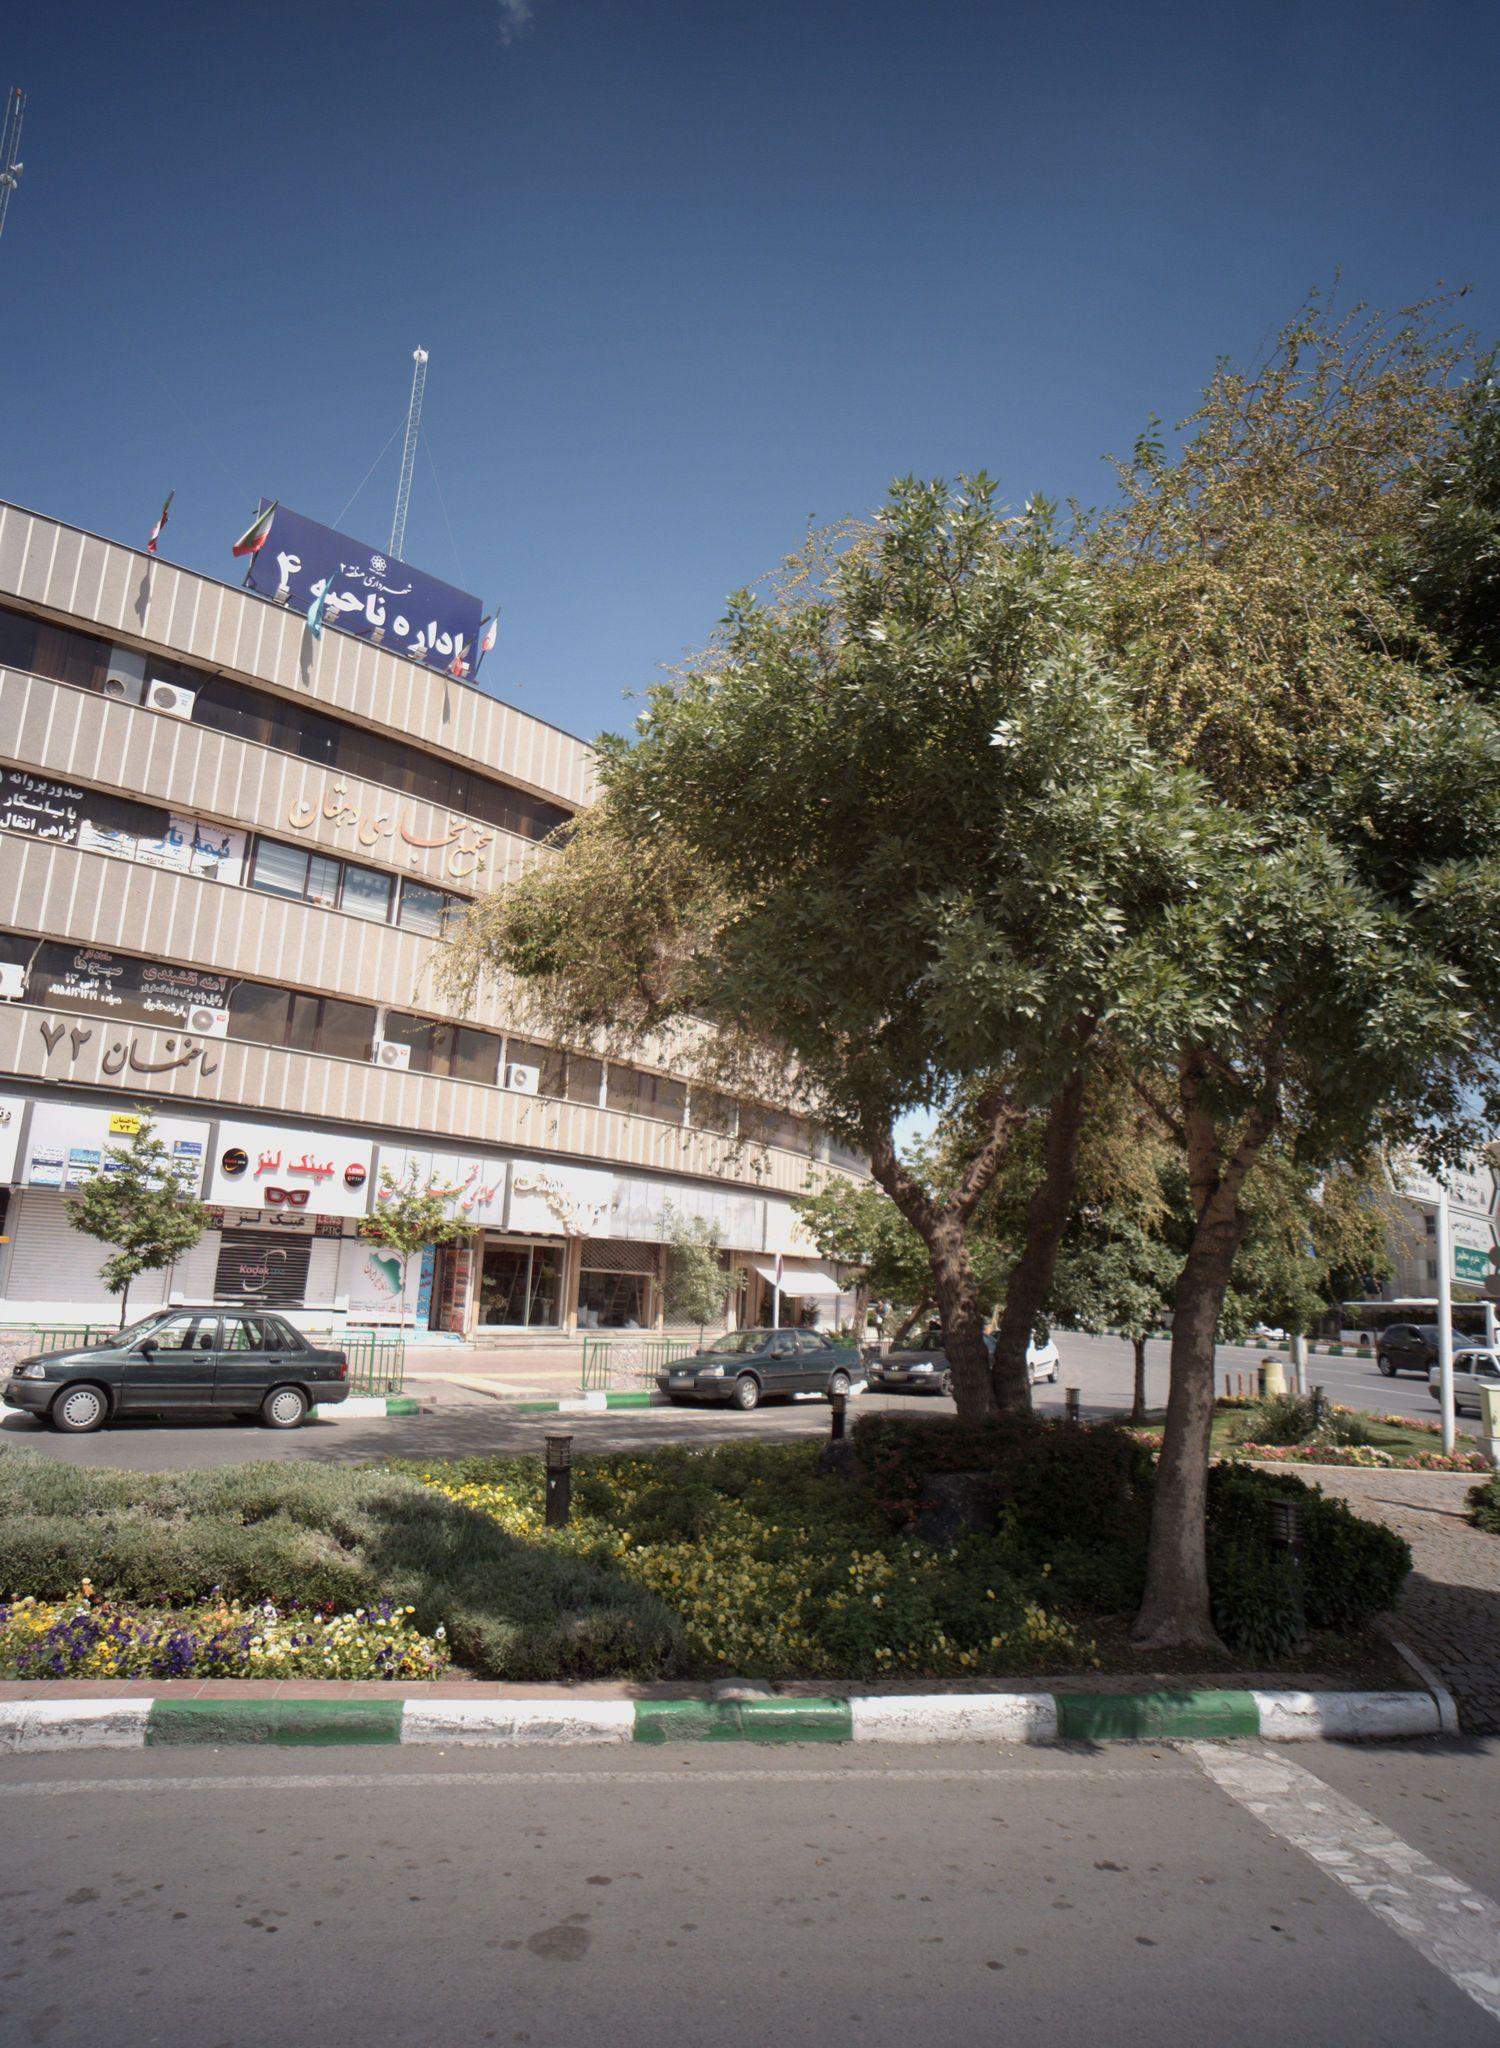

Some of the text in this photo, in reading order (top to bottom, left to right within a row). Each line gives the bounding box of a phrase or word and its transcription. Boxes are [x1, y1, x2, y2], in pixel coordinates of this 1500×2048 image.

[276, 551, 464, 658] اداره ناحیه ۴
[9, 773, 84, 799] صدور پروانه
[0, 813, 77, 842] گواهی انتقال
[40, 1021, 217, 1077] ساختمان ۷۲
[256, 1150, 335, 1181] عینک لنز
[236, 1211, 262, 1226] لنز
[269, 1213, 305, 1230] عینک
[240, 1264, 269, 1275] Kodak
